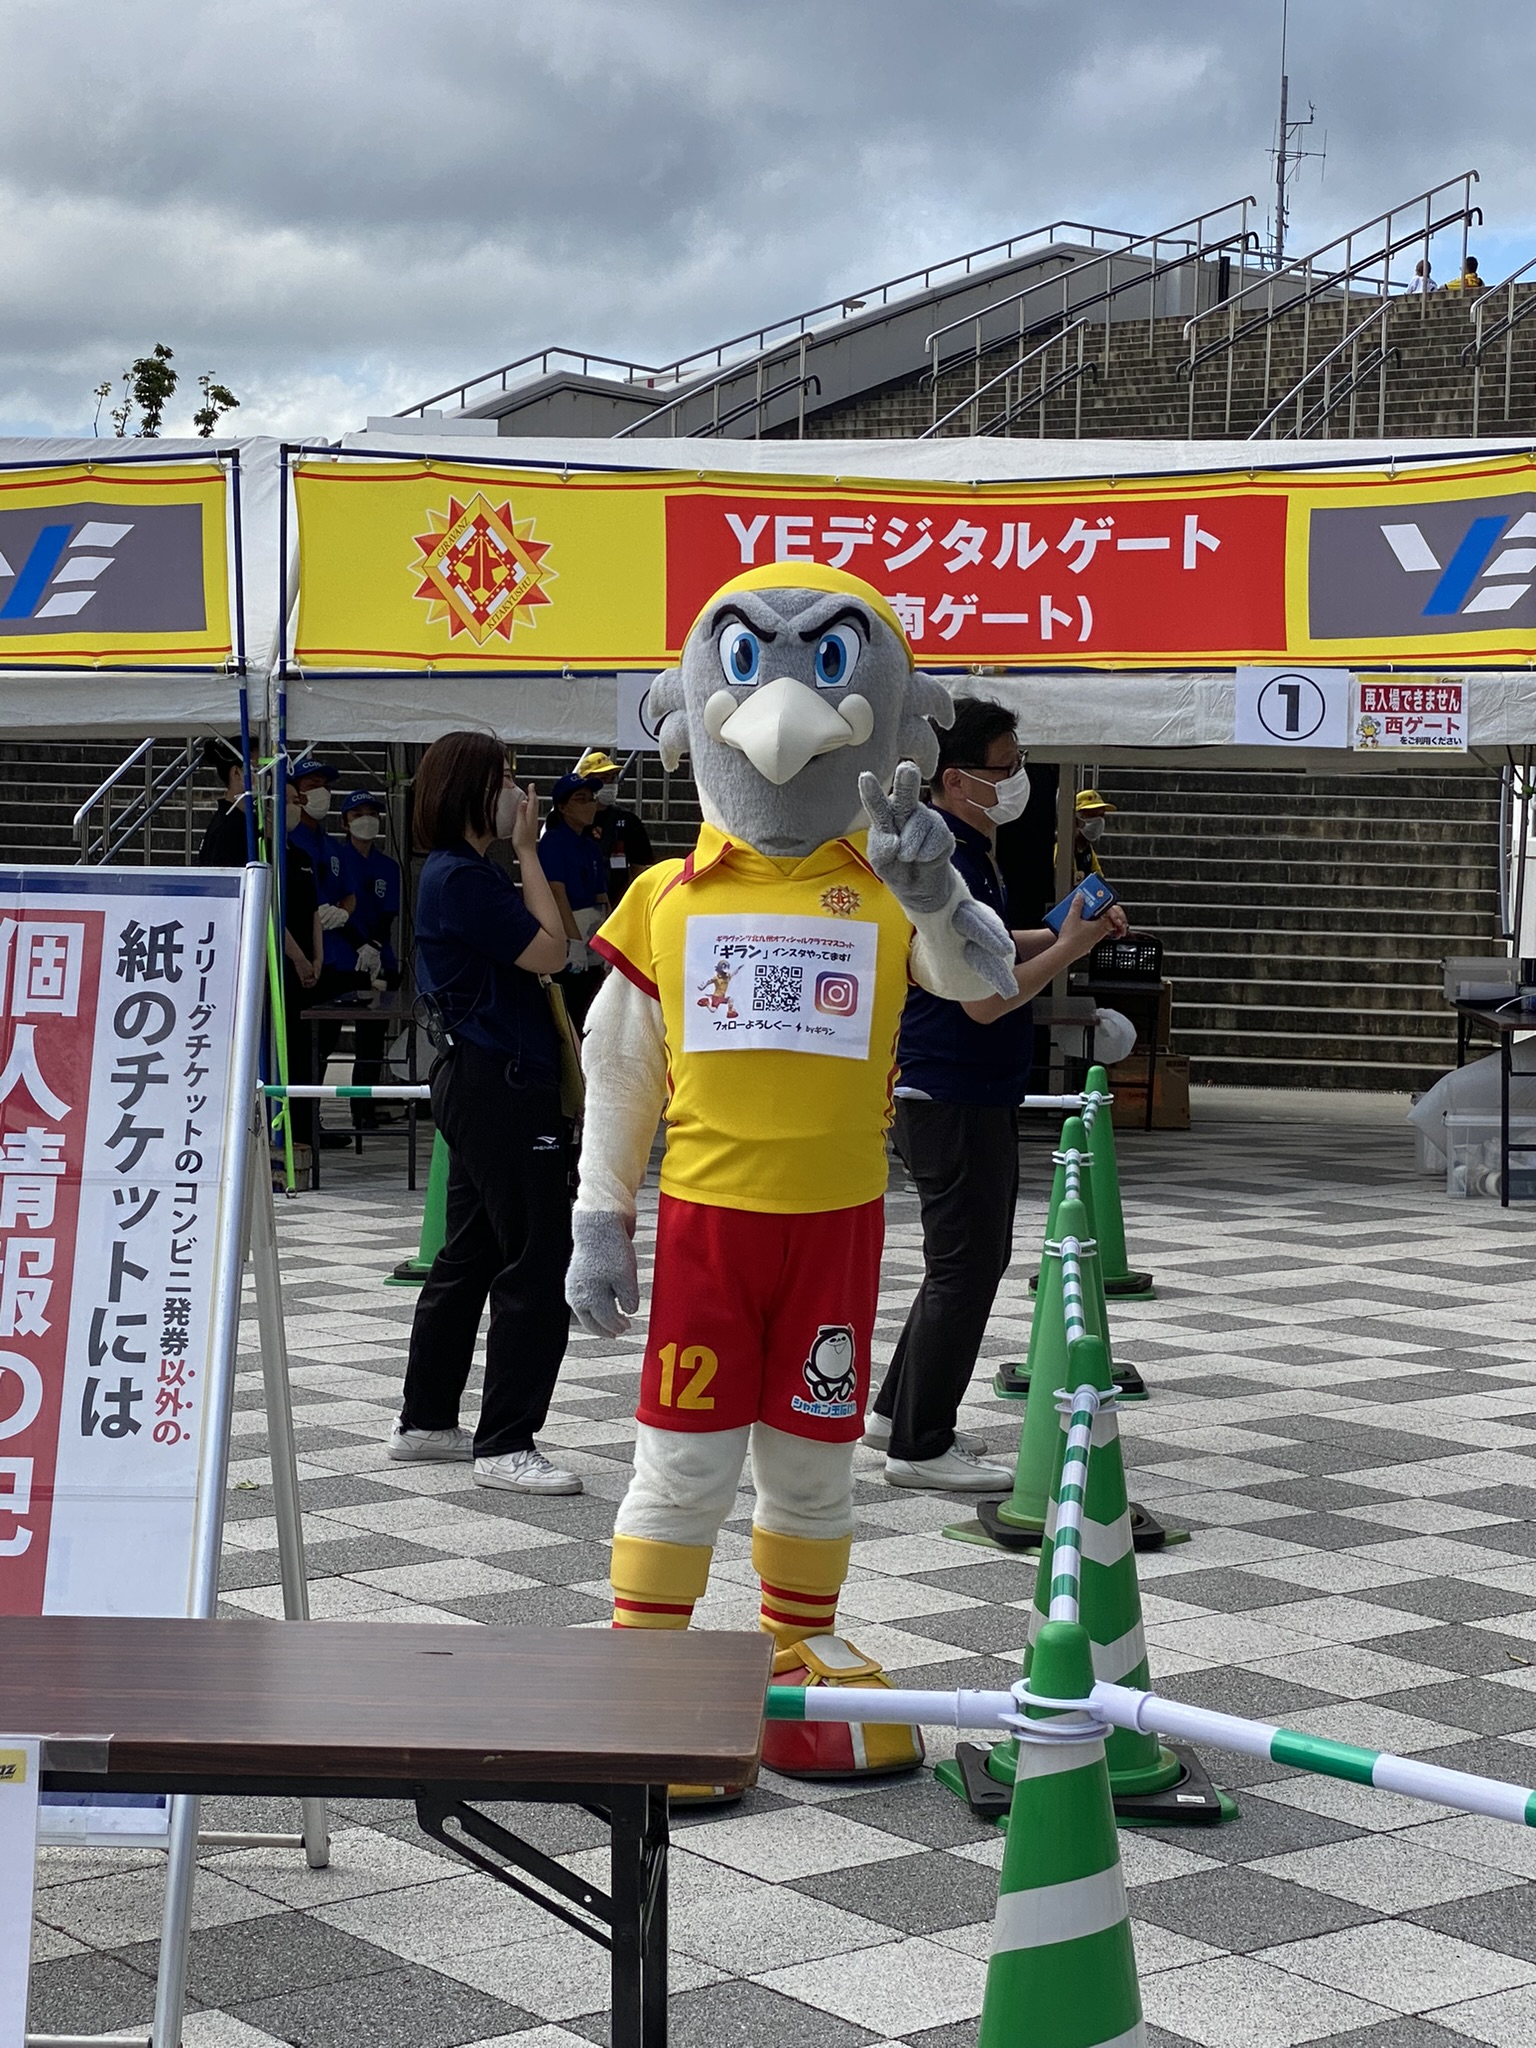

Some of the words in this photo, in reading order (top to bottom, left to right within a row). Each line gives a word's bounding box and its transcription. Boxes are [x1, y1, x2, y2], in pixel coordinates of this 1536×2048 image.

[436, 517, 470, 558] GIRAVANZ
[724, 514, 1221, 575] YEデジタルゲート
[486, 576, 532, 629] KITAKYUSHU
[1365, 688, 1460, 711] 再入場できません
[1385, 716, 1460, 735] 西ゲート
[1400, 736, 1462, 746] をご利用ください
[713, 1020, 792, 1031] フォローよろしくー
[80, 919, 185, 1439] 紙のチケットには
[658, 1342, 719, 1410] 12
